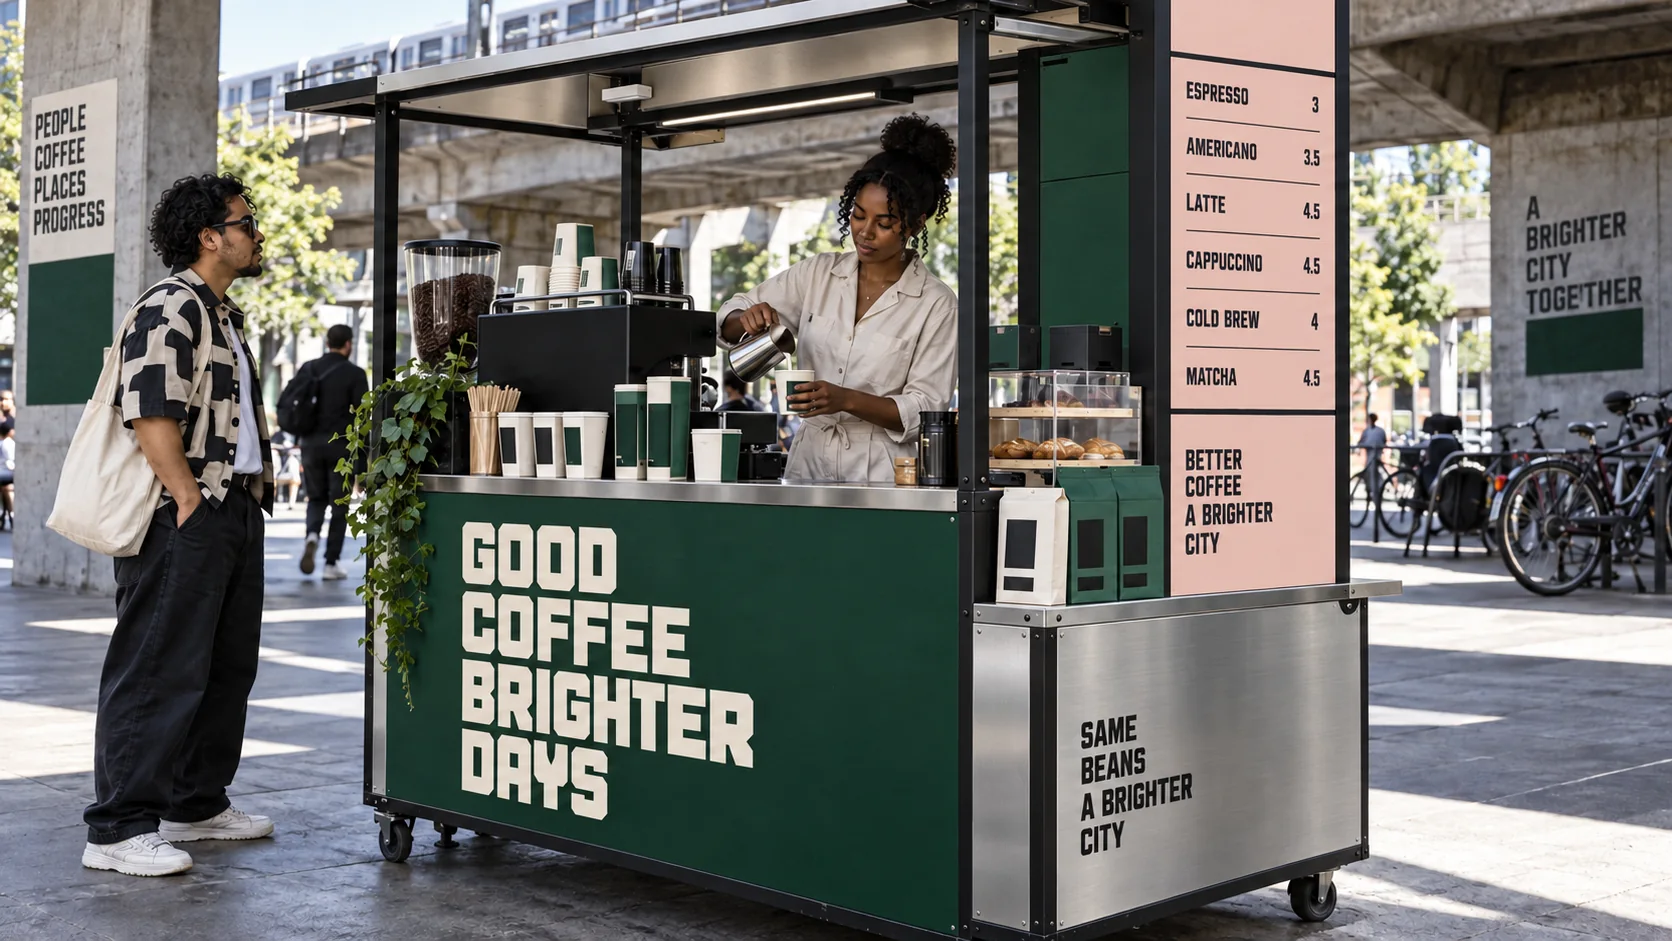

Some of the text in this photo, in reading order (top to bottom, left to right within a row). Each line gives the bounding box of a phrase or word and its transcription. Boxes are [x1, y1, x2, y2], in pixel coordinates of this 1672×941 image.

[1187, 81, 1319, 114] ESPRESSO 3
[36, 104, 87, 140] PEOPLE
[35, 137, 86, 172] COFFEE
[1187, 136, 1321, 167] AMERICANO 3.5
[35, 170, 86, 204] PLACES
[34, 199, 105, 236] PROGRESS
[1187, 192, 1321, 220] LATTE 4.5
[1527, 196, 1541, 221] A
[1527, 211, 1627, 252] BRIGHTER
[1186, 250, 1321, 275] CAPPUCCINO 4.5
[1527, 252, 1572, 283] CITY
[1186, 308, 1319, 331] COLD BREW 4
[1187, 367, 1321, 387] MATCHA 4.5
[1186, 449, 1243, 471] BETTER
[1186, 475, 1242, 498] COFFEE
[1185, 502, 1273, 527] A BRIGHTER
[462, 521, 617, 595] GOOD
[1186, 532, 1220, 556] CITY
[462, 590, 690, 679] COFFEE
[461, 658, 754, 769] BRIGHTER
[1081, 714, 1137, 750] SAME
[461, 728, 609, 821] DAYS
[1081, 748, 1146, 785] BEANS
[1081, 773, 1193, 822] A BRIGHTER
[1081, 821, 1125, 856] CITY
